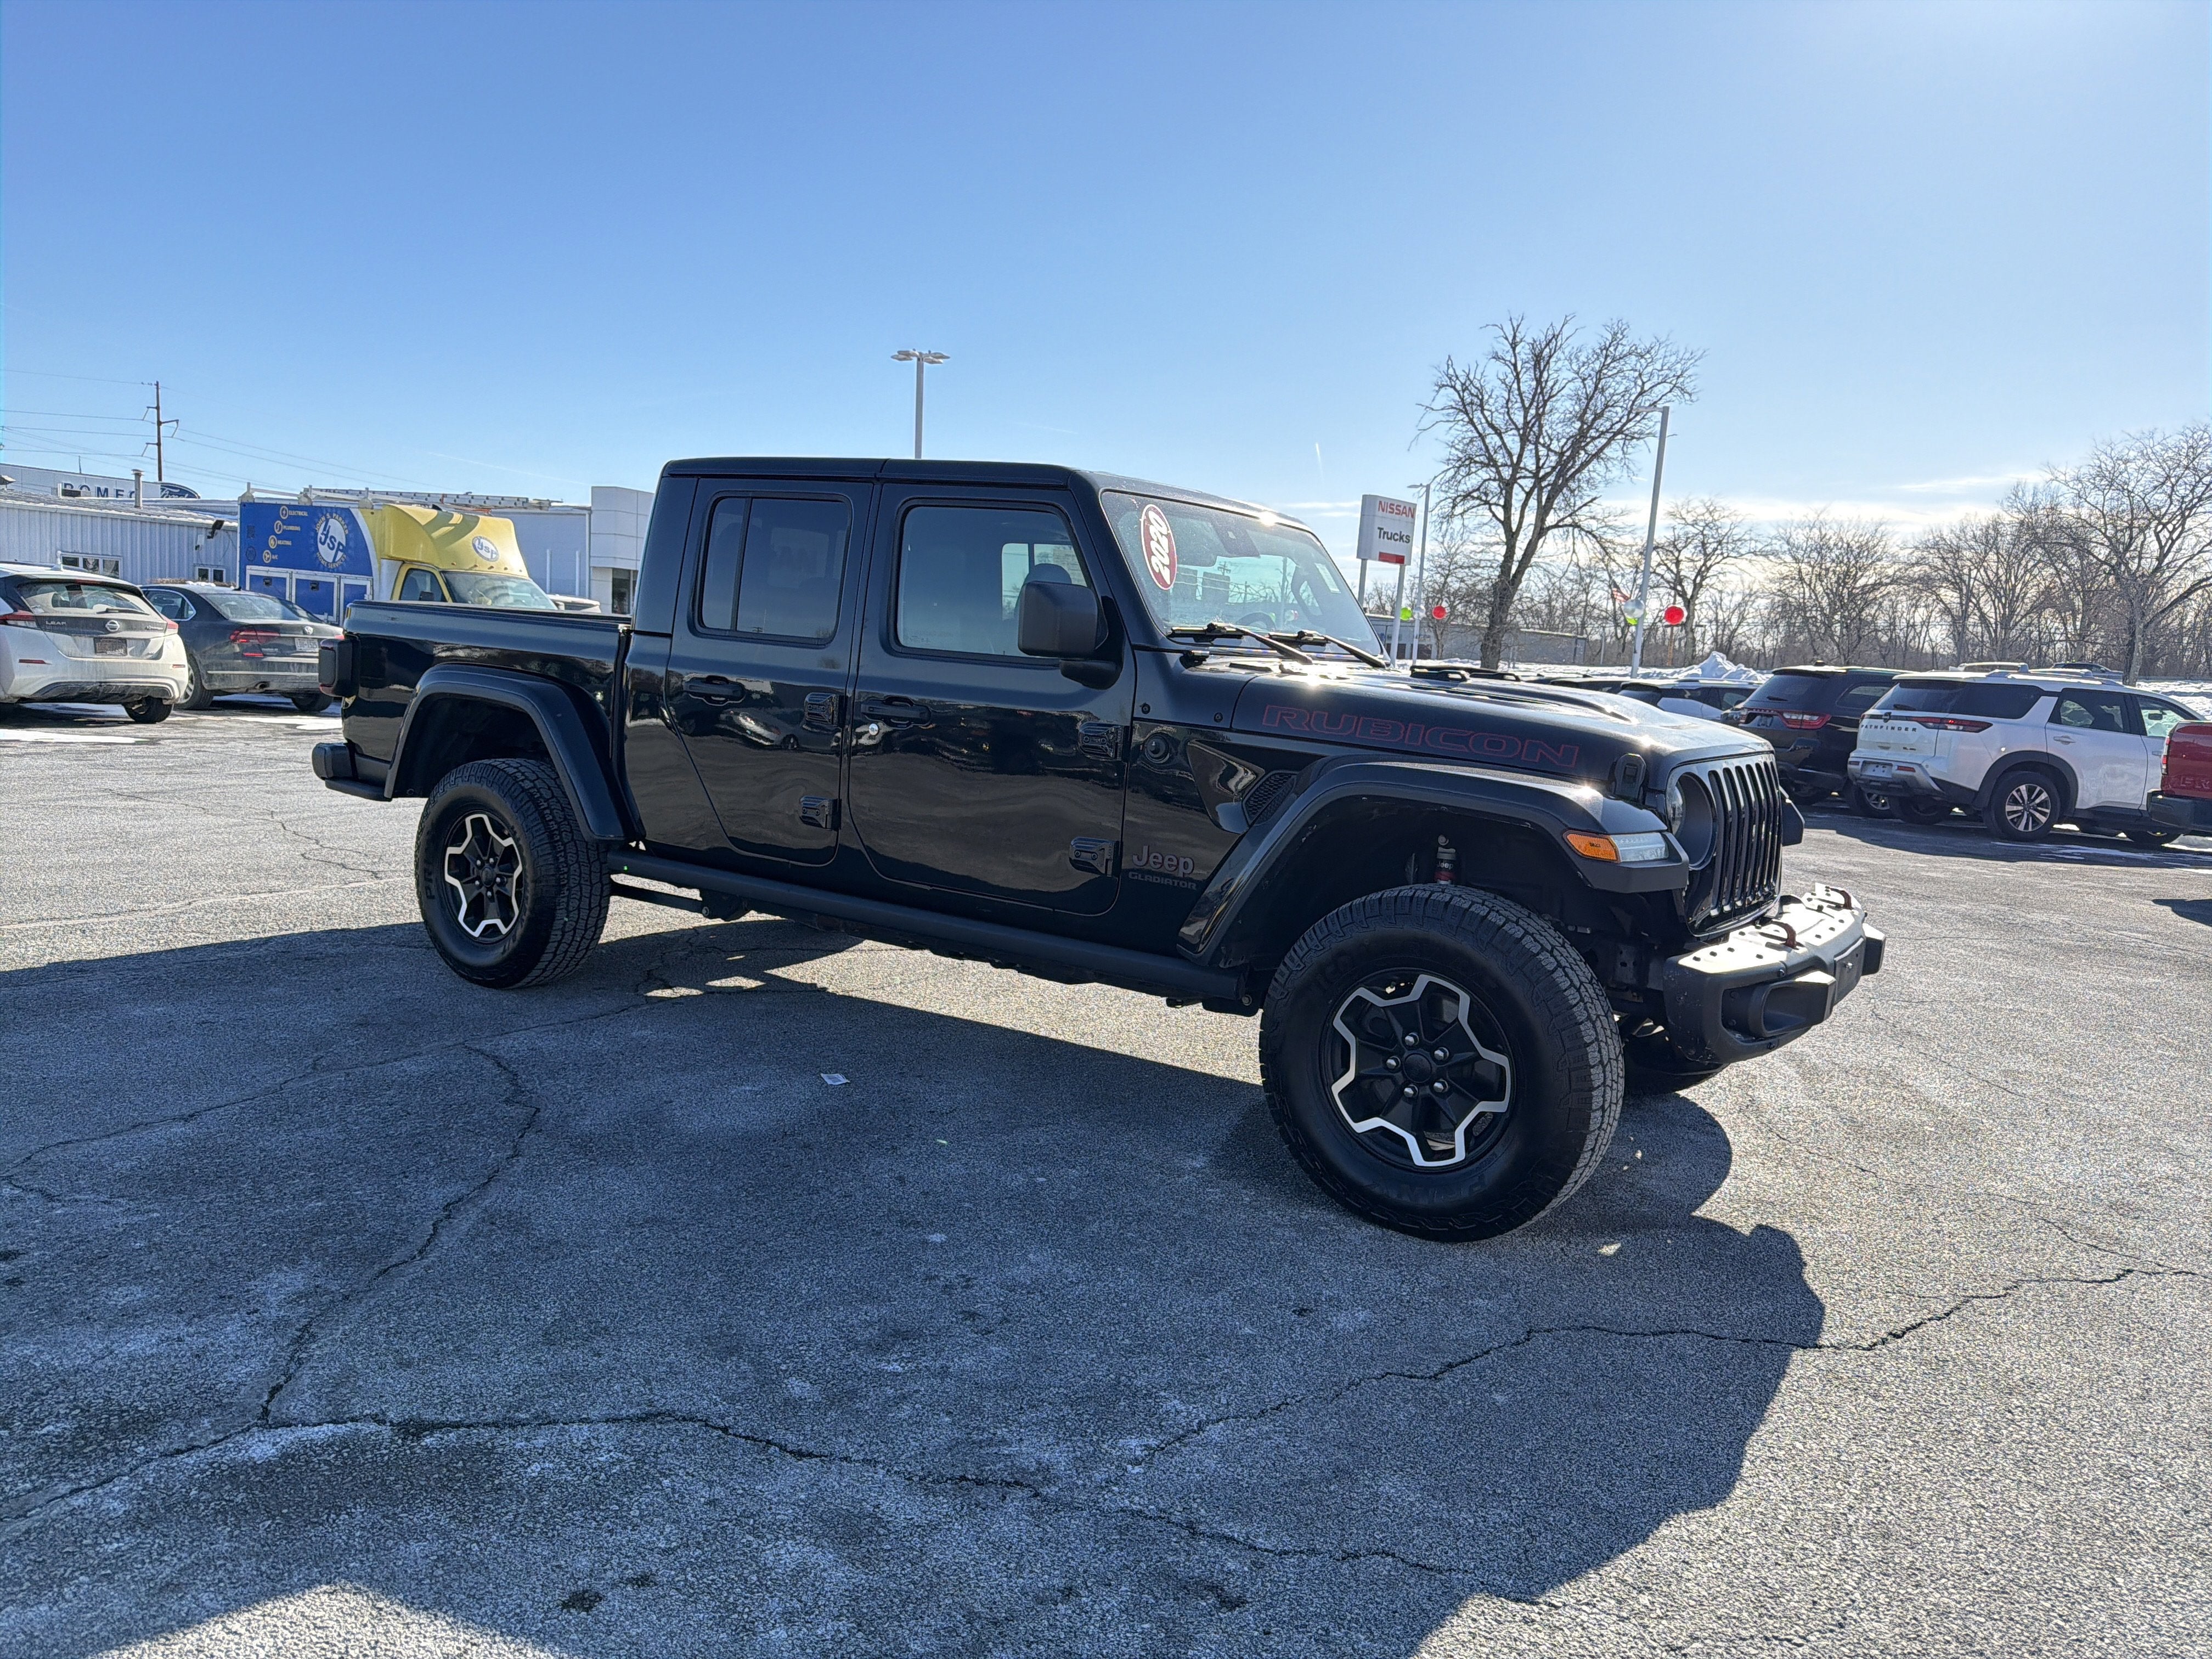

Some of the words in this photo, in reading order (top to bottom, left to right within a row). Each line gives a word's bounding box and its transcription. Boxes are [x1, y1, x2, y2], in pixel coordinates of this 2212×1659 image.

[1378, 500, 1415, 519] NISSAN
[315, 515, 326, 533] JOHN
[332, 513, 349, 535] PARKER
[1377, 527, 1410, 544] Trucks
[1148, 510, 1171, 585] 2020
[316, 551, 328, 567] HOME
[1262, 704, 1579, 768] RUBICON
[1860, 724, 1917, 732] PATHFINDER
[1132, 845, 1194, 878] Jeep
[1437, 860, 1454, 870] Jeep
[1128, 872, 1197, 890] GLADIATOR
